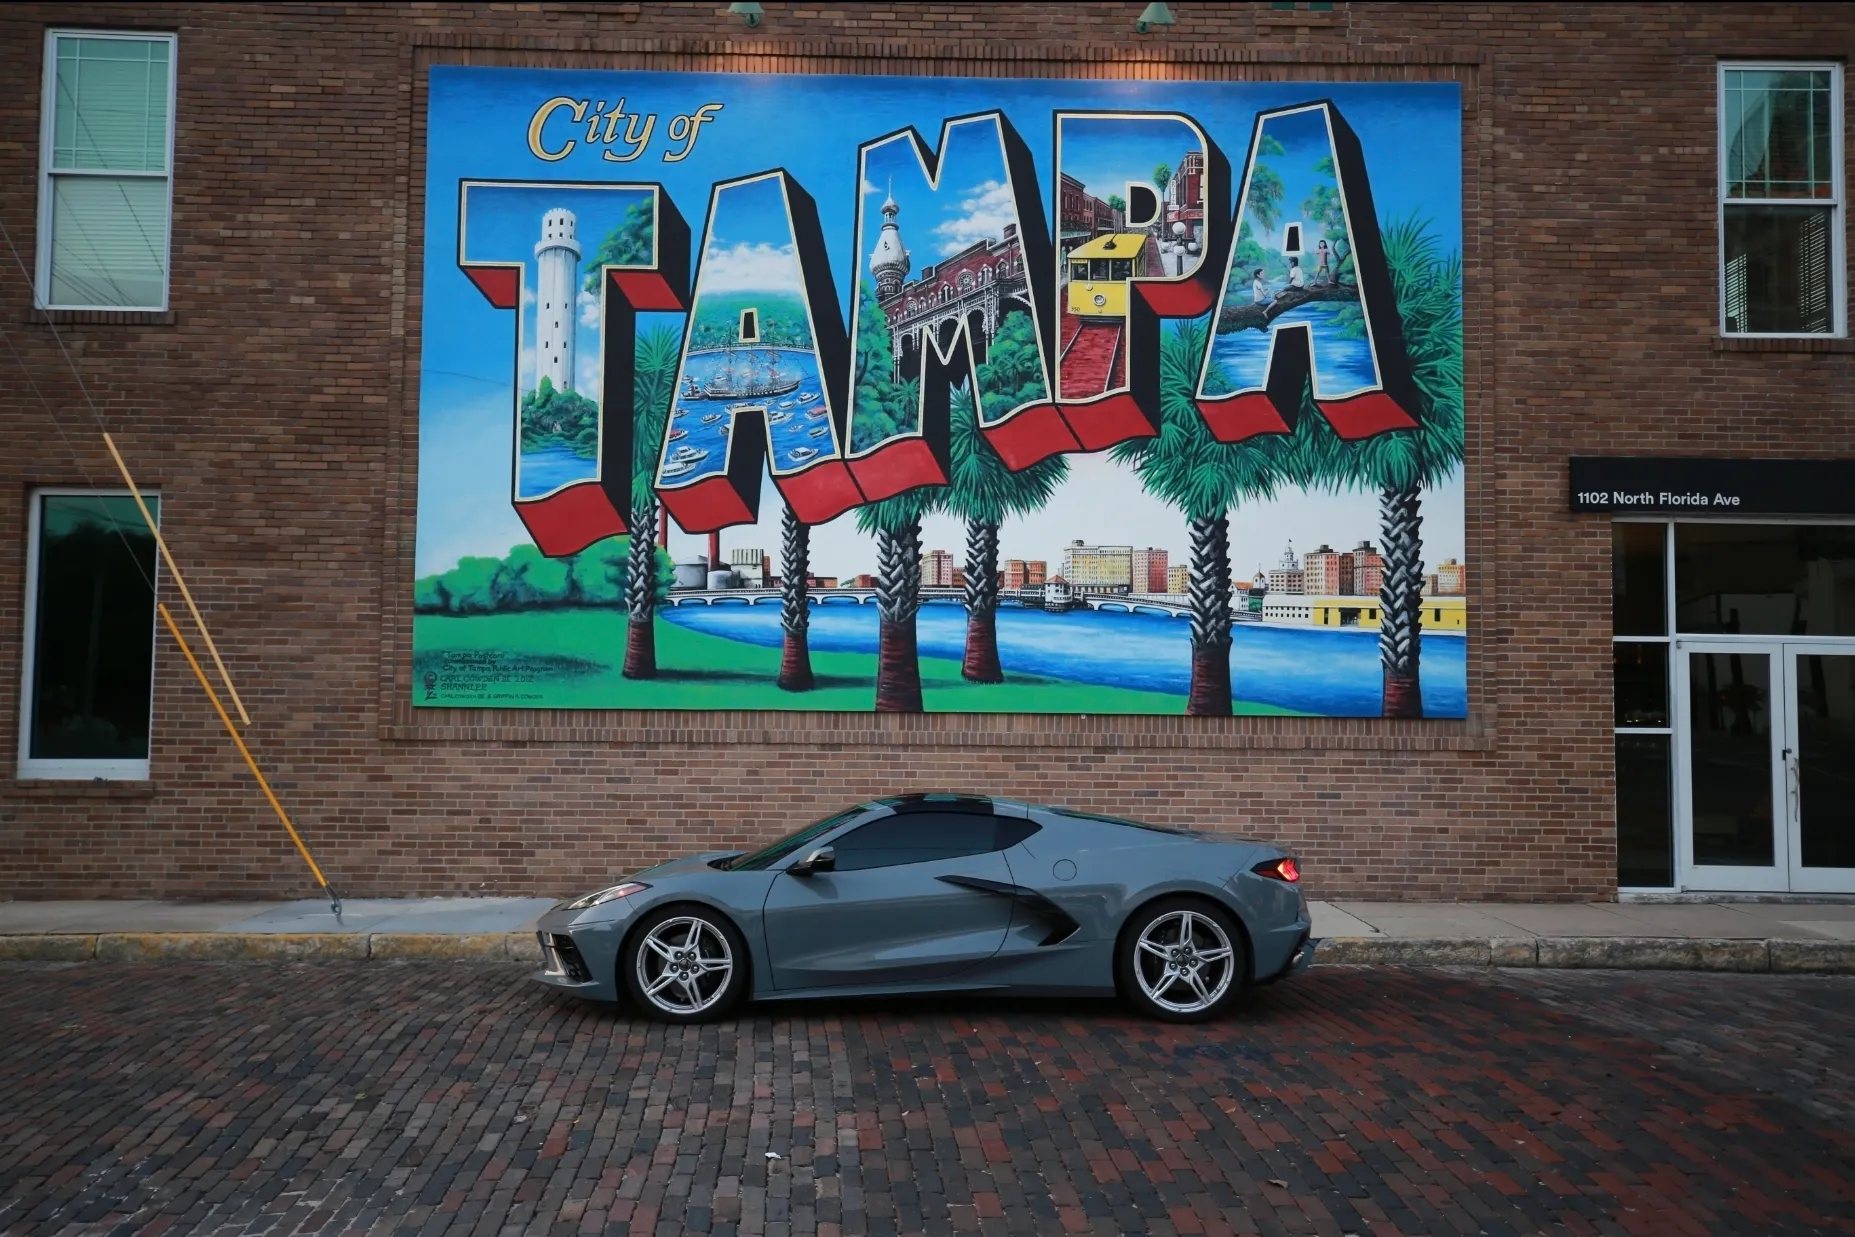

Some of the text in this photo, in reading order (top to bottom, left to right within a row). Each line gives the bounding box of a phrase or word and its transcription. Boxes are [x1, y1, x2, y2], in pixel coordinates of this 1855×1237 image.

[527, 96, 724, 162] City of
[457, 98, 1421, 557] TAMPA
[1577, 491, 1740, 506] 1102 North Florida Ave
[443, 664, 457, 673] City
[468, 664, 491, 673] Tampa
[492, 664, 511, 672] Public
[512, 664, 524, 672] Art
[525, 665, 554, 674] Program
[515, 675, 534, 683] 2012
